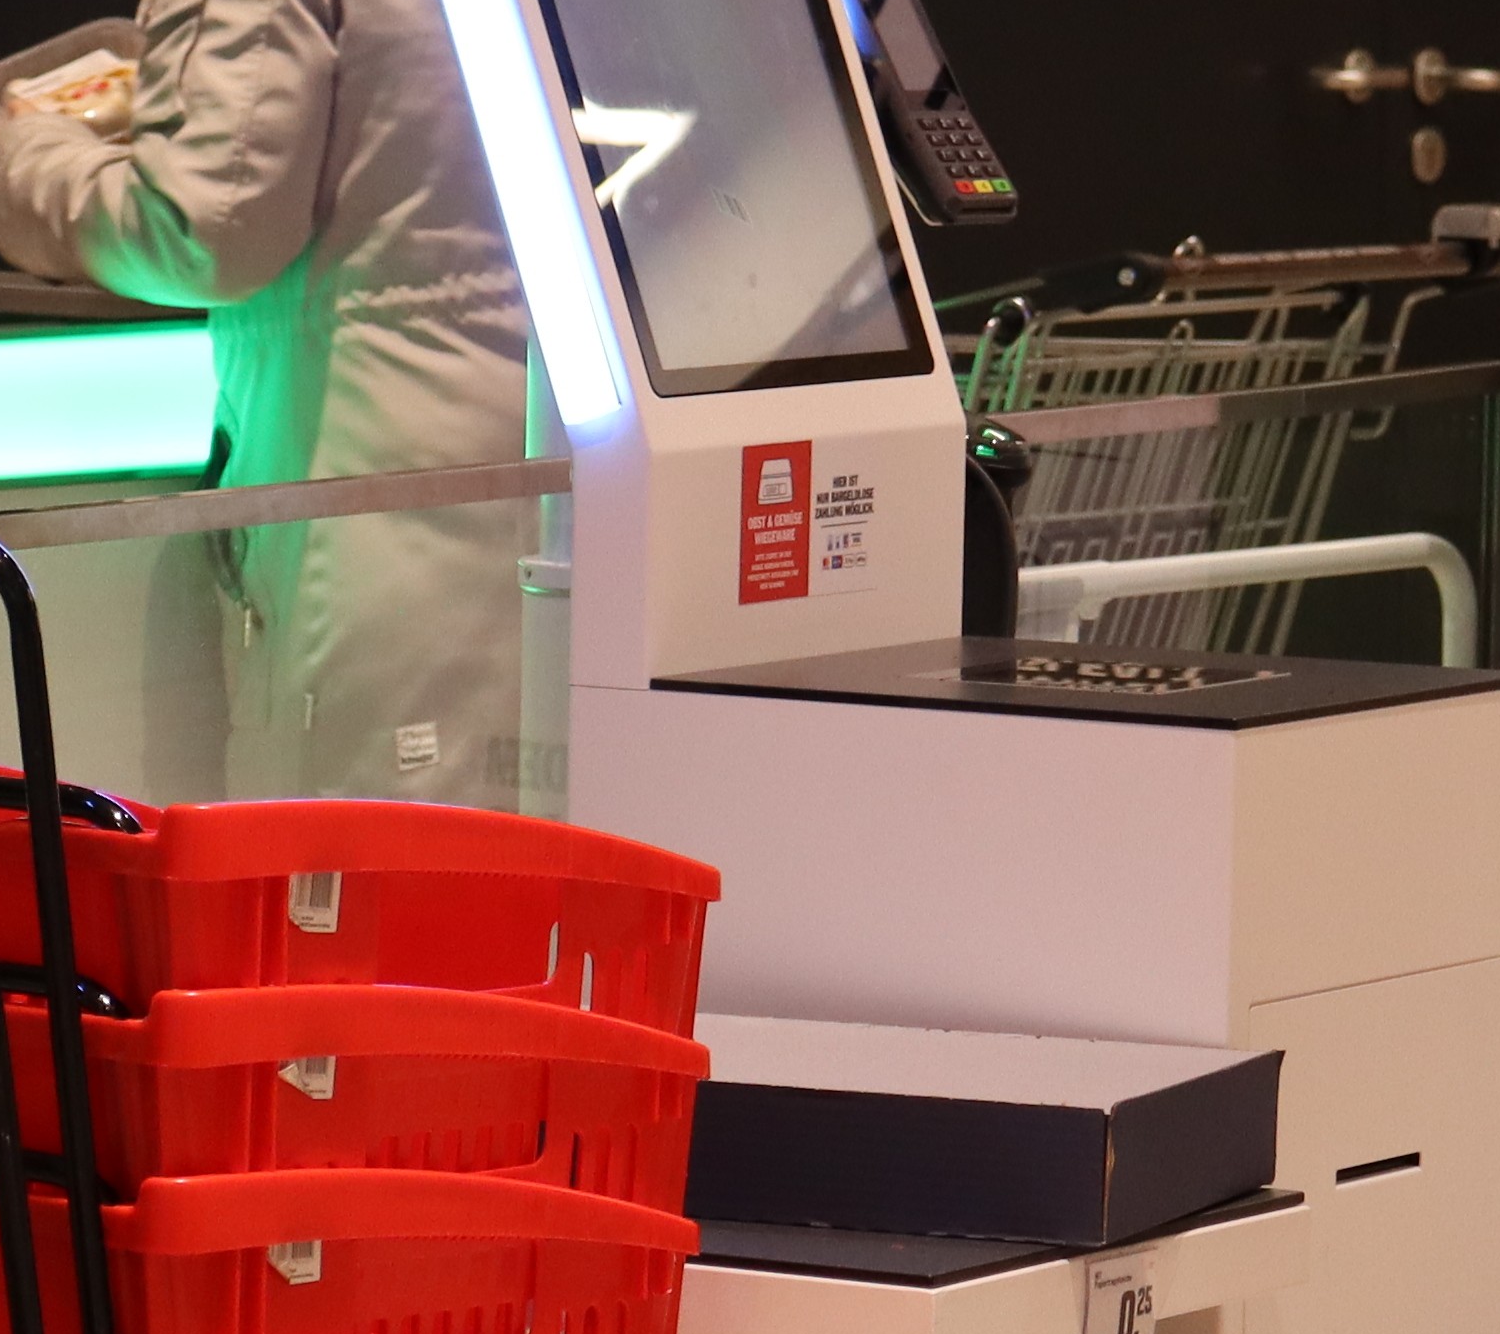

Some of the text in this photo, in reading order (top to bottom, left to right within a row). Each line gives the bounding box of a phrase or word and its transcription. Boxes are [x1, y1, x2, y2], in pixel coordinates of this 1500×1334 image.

[833, 476, 847, 488] HIER
[831, 487, 874, 503] BARGELDLOSE
[815, 506, 843, 519] ZAHLUNG
